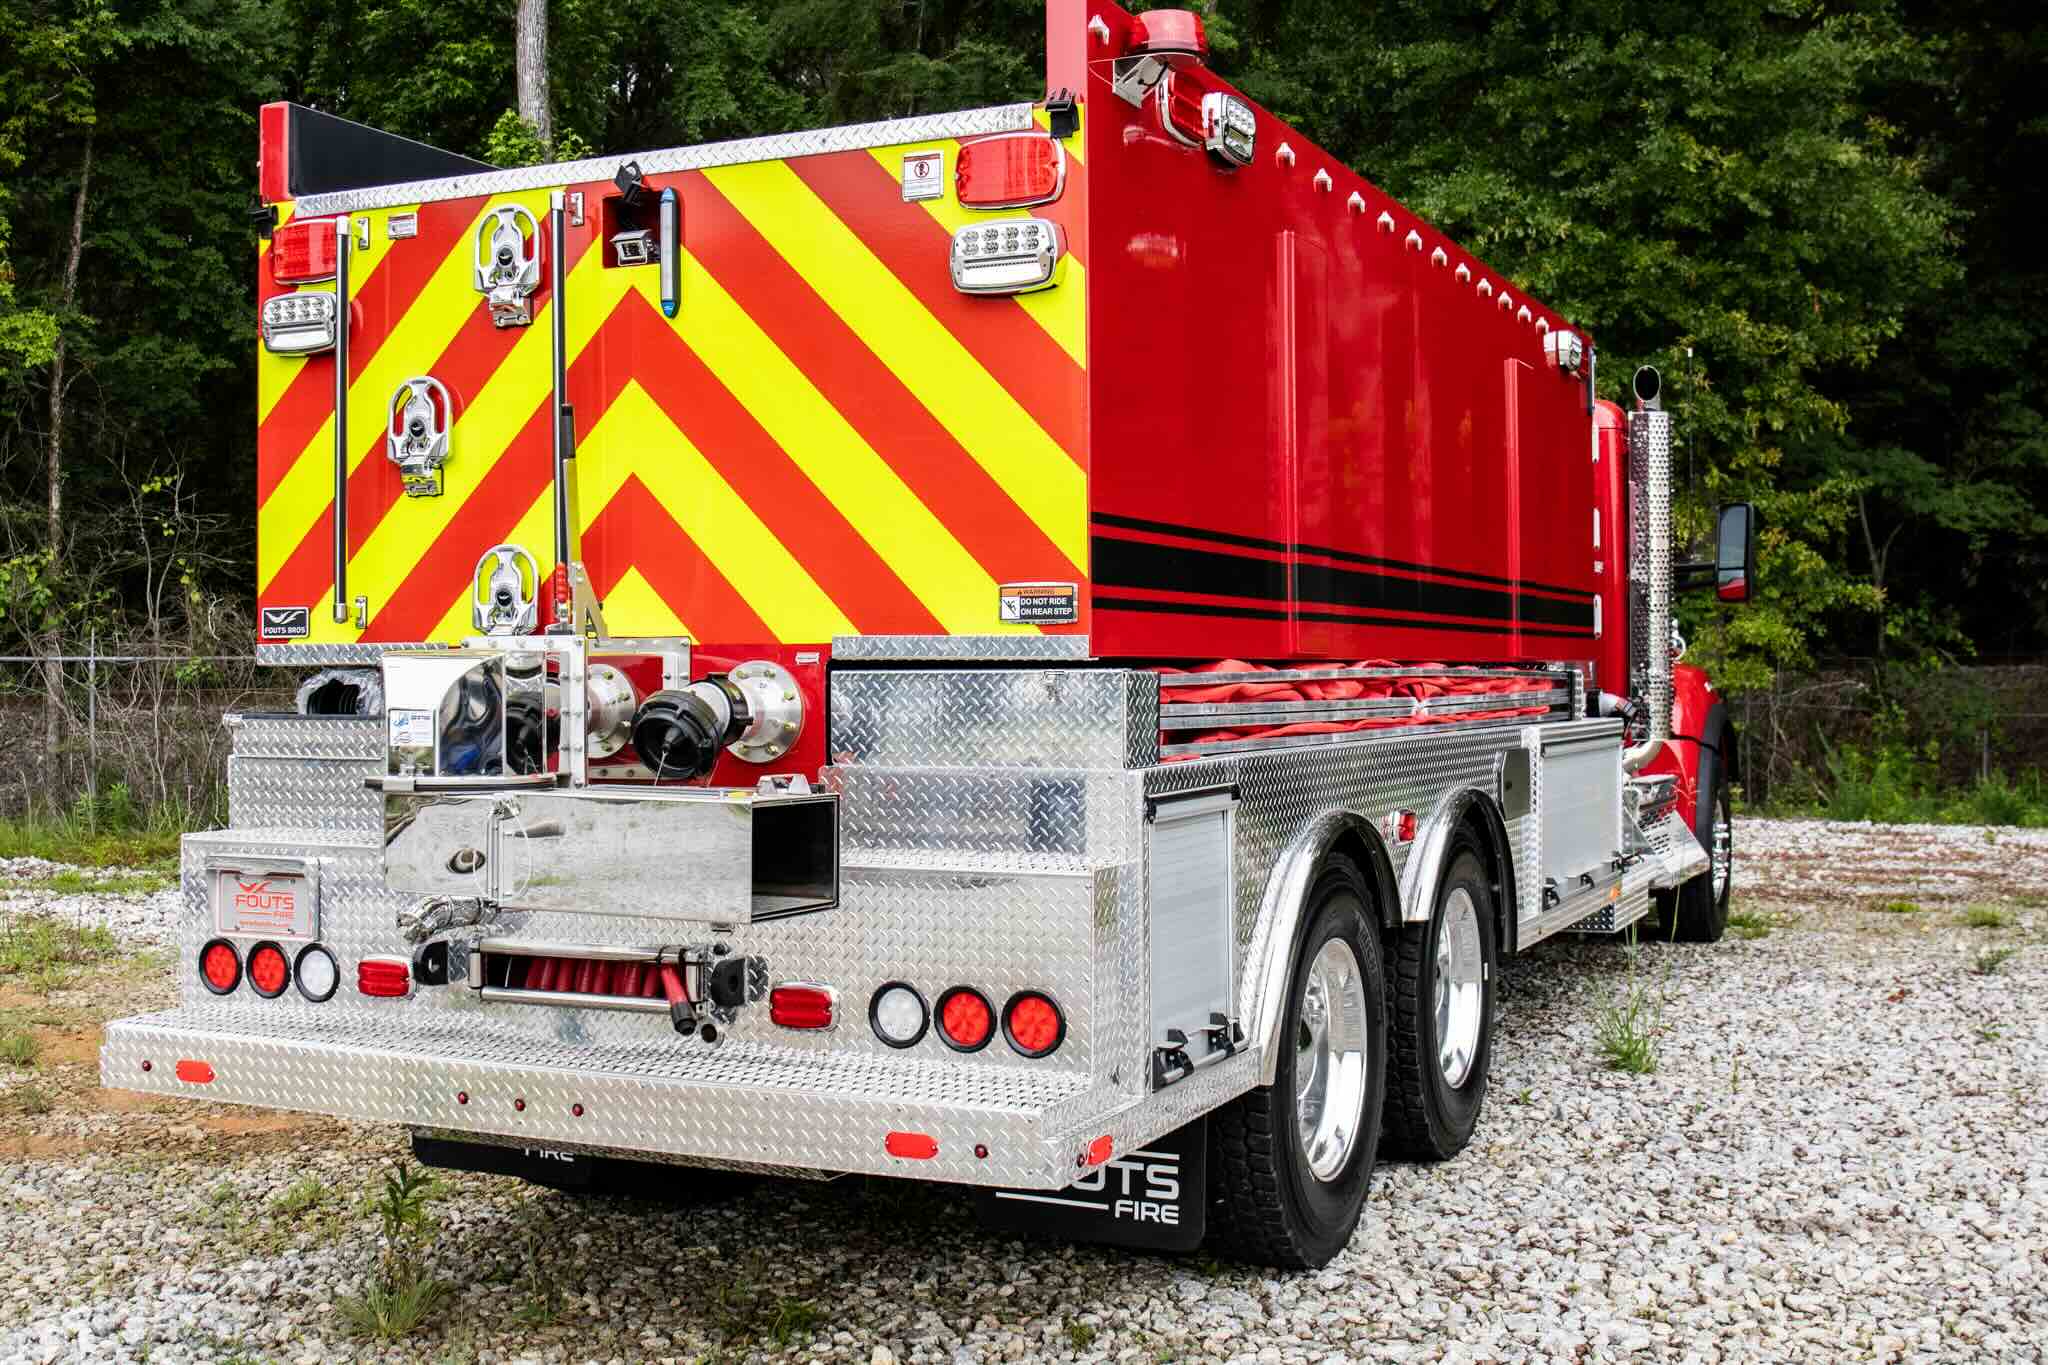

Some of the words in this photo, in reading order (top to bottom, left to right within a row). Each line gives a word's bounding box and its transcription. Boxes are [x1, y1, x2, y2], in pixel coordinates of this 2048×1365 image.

[1032, 597, 1047, 605] NOT
[1049, 597, 1067, 605] RIDE
[1054, 607, 1073, 615] STEP
[264, 626, 287, 634] FOUTS
[287, 626, 306, 634] BROS
[235, 894, 295, 911] FOUTS
[1114, 1198, 1180, 1226] FIRE
